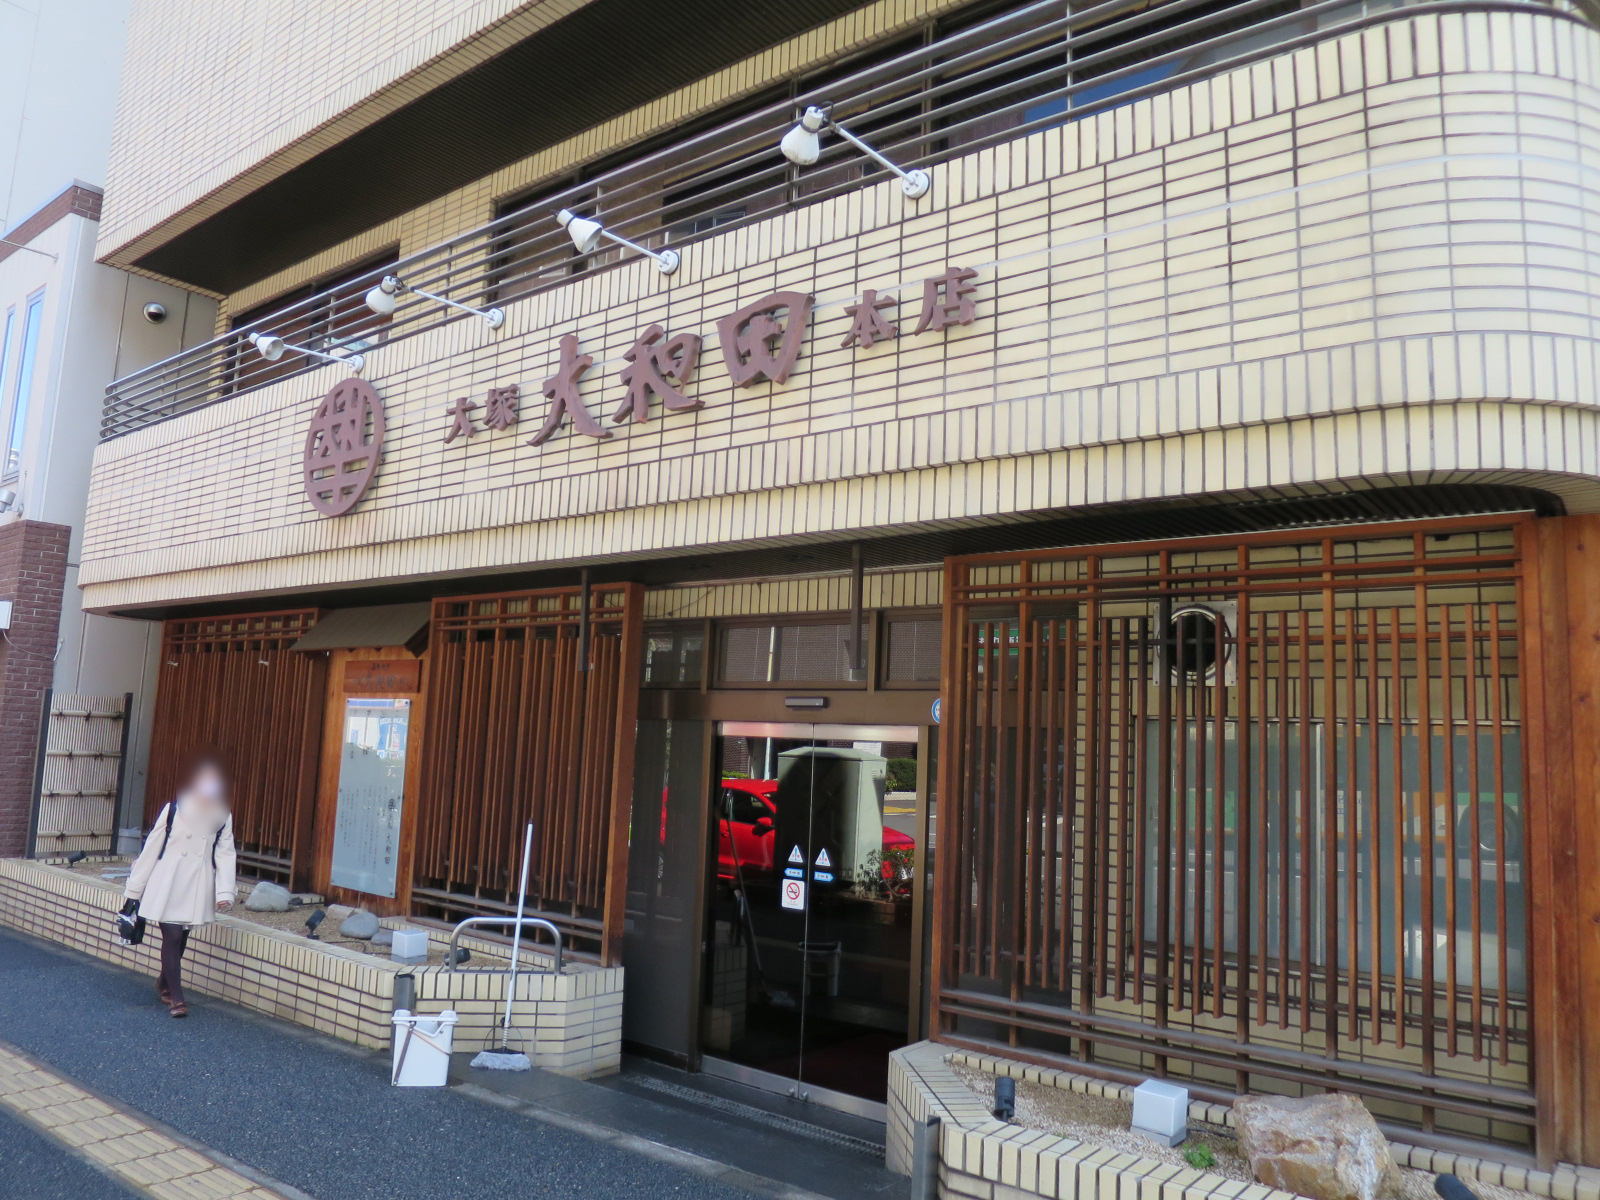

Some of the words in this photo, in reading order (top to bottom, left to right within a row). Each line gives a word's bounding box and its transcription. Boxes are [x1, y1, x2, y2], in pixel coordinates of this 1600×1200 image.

[444, 384, 519, 444] 大塚
[525, 291, 816, 447] 大和田
[841, 267, 979, 349] 本店
